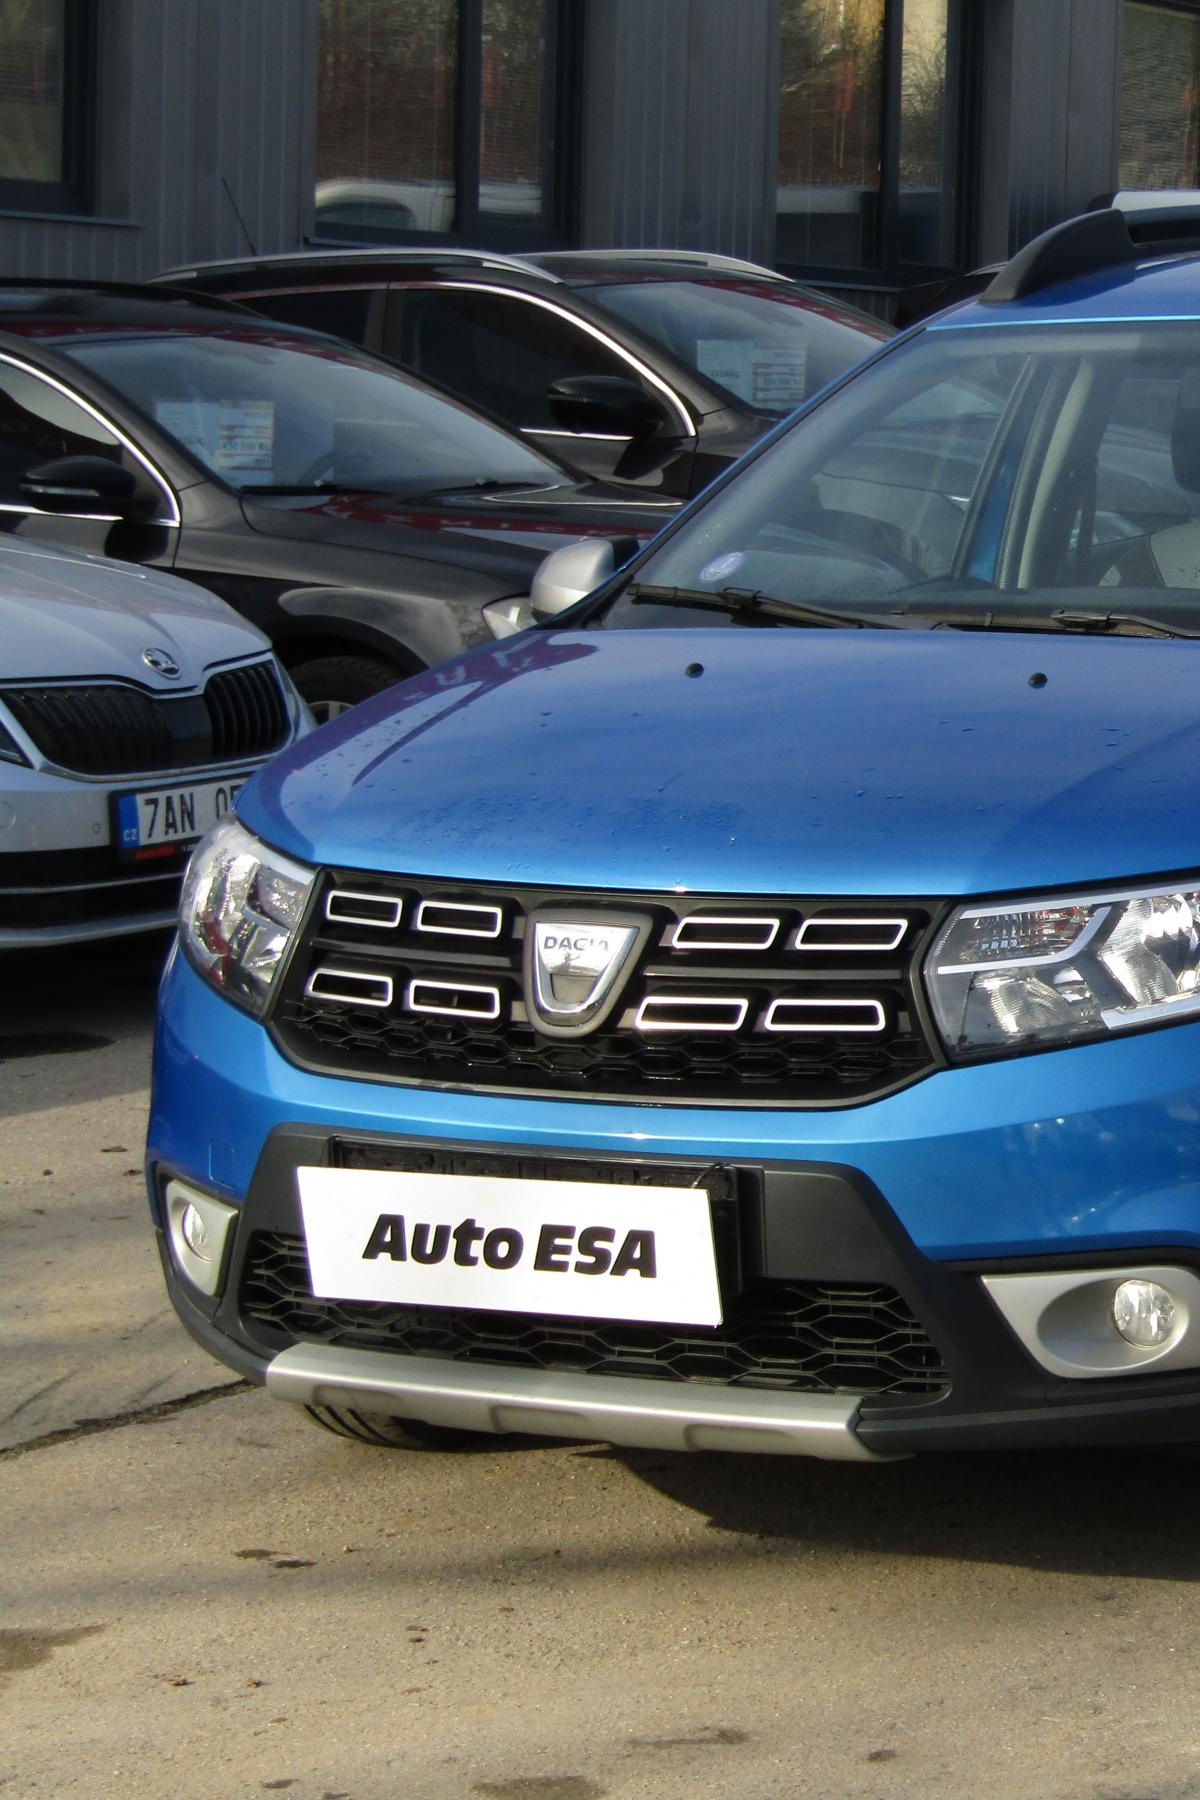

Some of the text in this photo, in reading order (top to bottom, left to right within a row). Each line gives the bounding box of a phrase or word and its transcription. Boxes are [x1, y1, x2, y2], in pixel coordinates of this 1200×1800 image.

[123, 829, 138, 841] CZ
[144, 793, 195, 838] 7AN
[361, 1213, 657, 1279] Auto ESA
